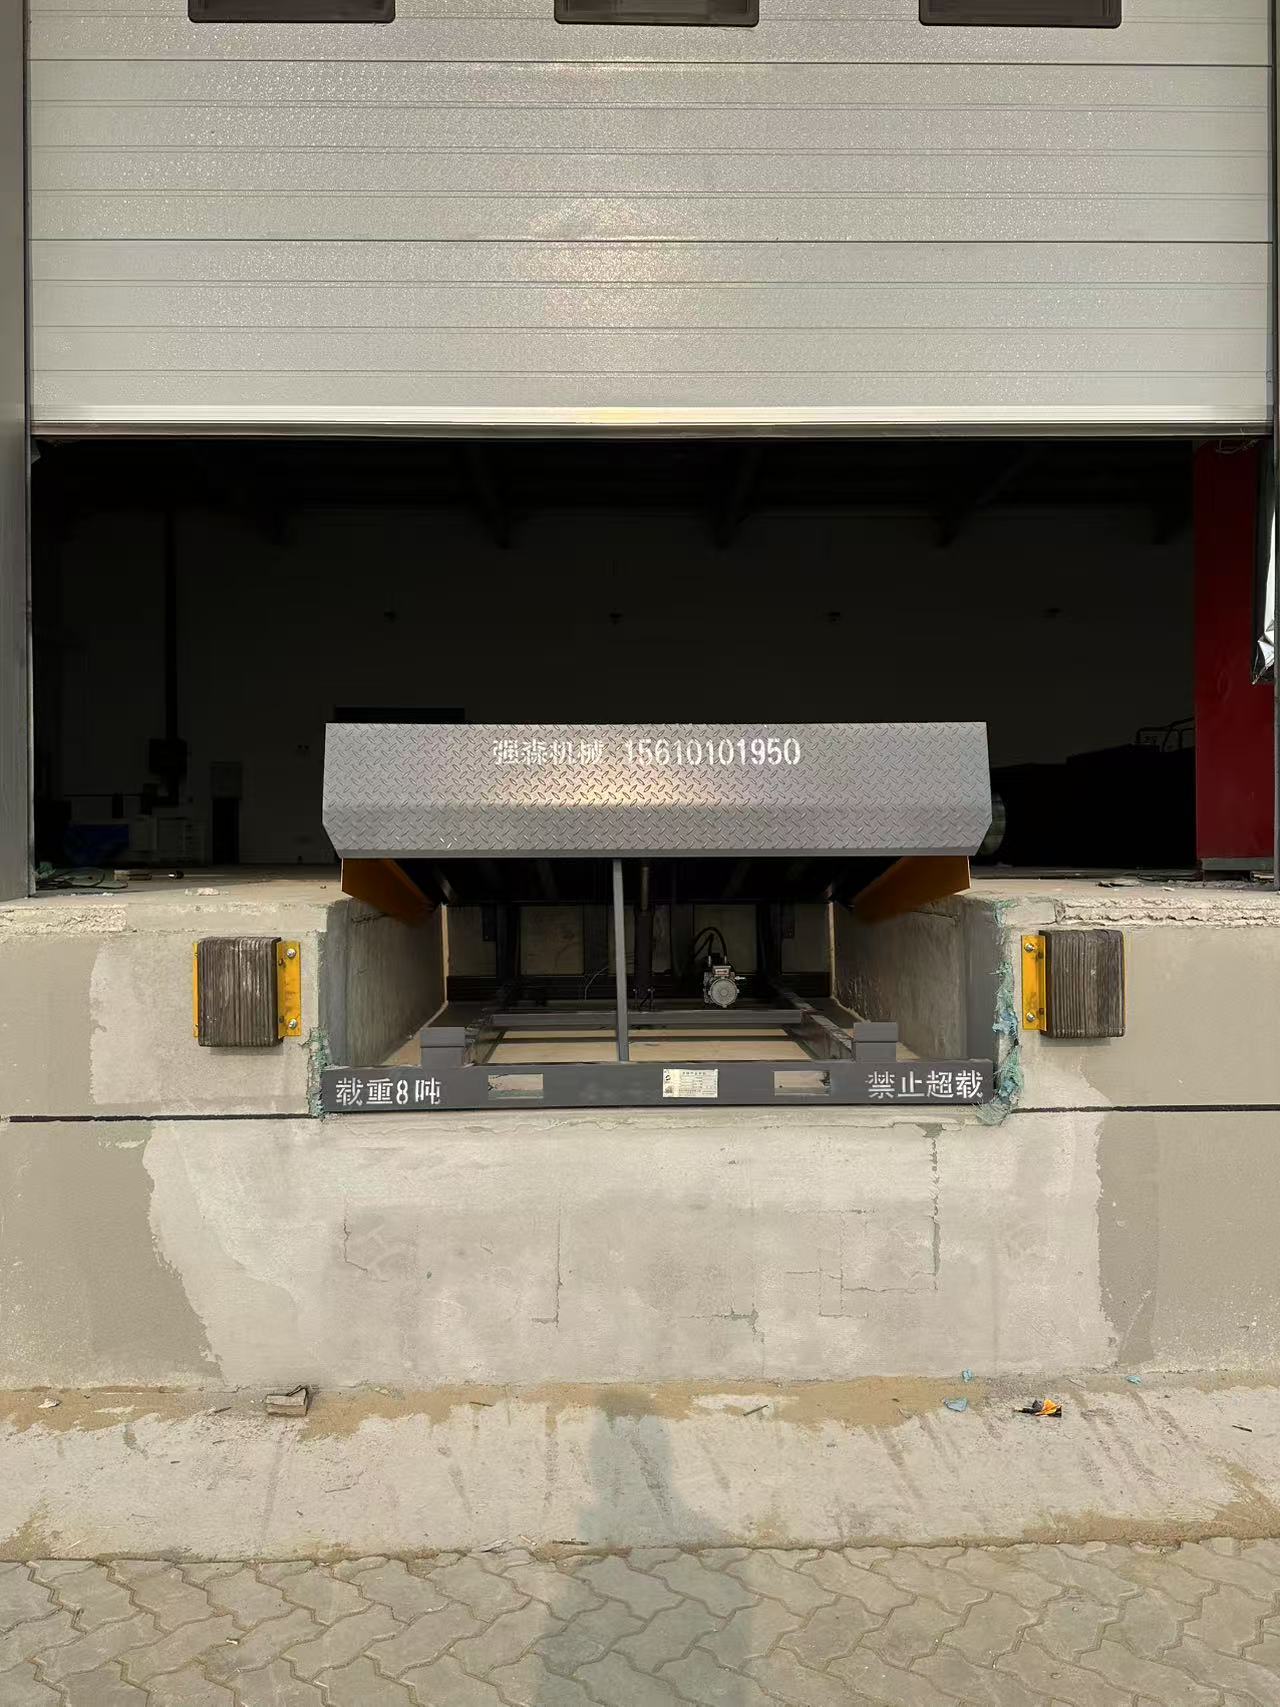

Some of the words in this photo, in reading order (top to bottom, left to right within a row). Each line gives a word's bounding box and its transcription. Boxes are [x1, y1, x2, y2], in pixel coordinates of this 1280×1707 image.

[624, 738, 801, 765] 15610101950
[336, 1077, 441, 1106] 载重8吨
[865, 1070, 983, 1098] 禁止超载
